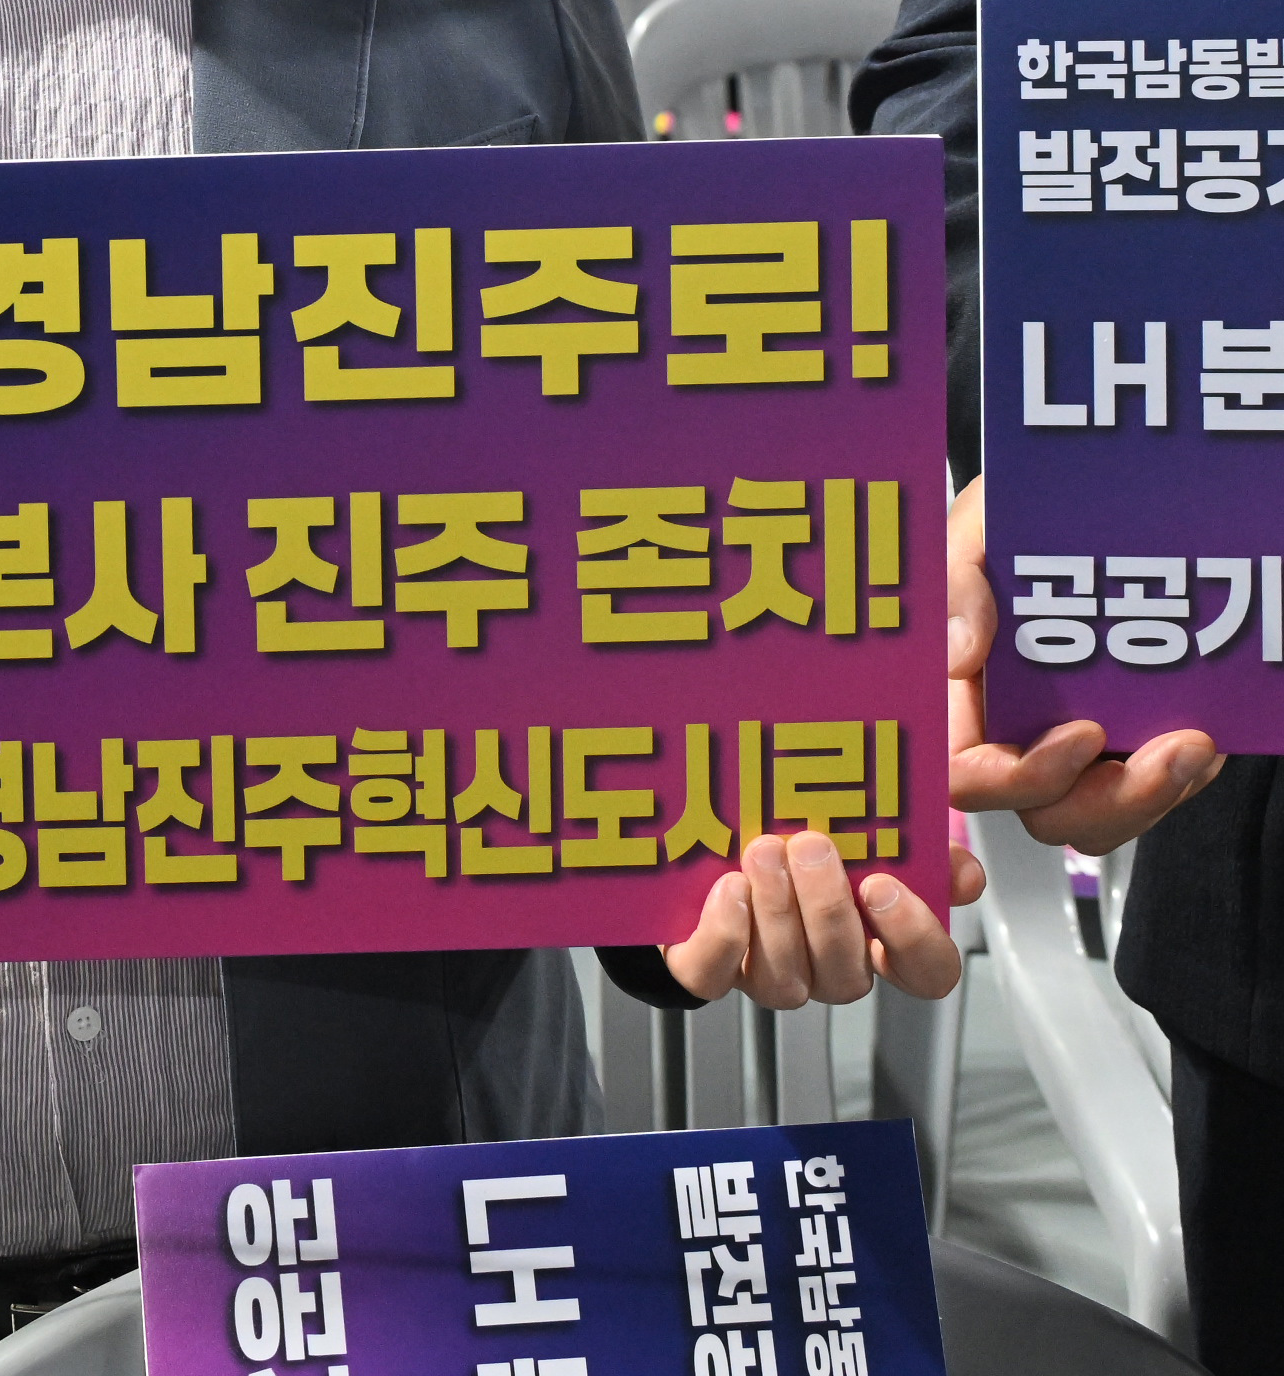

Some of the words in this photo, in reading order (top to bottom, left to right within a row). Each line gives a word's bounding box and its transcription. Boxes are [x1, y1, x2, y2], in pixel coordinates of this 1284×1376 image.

[1023, 322, 1167, 426] LH
[247, 492, 528, 652] 진주
[578, 478, 899, 642] 존치!
[1013, 556, 1284, 664] 공공기
[227, 1178, 349, 1376] 공공
[462, 1174, 580, 1326] LH
